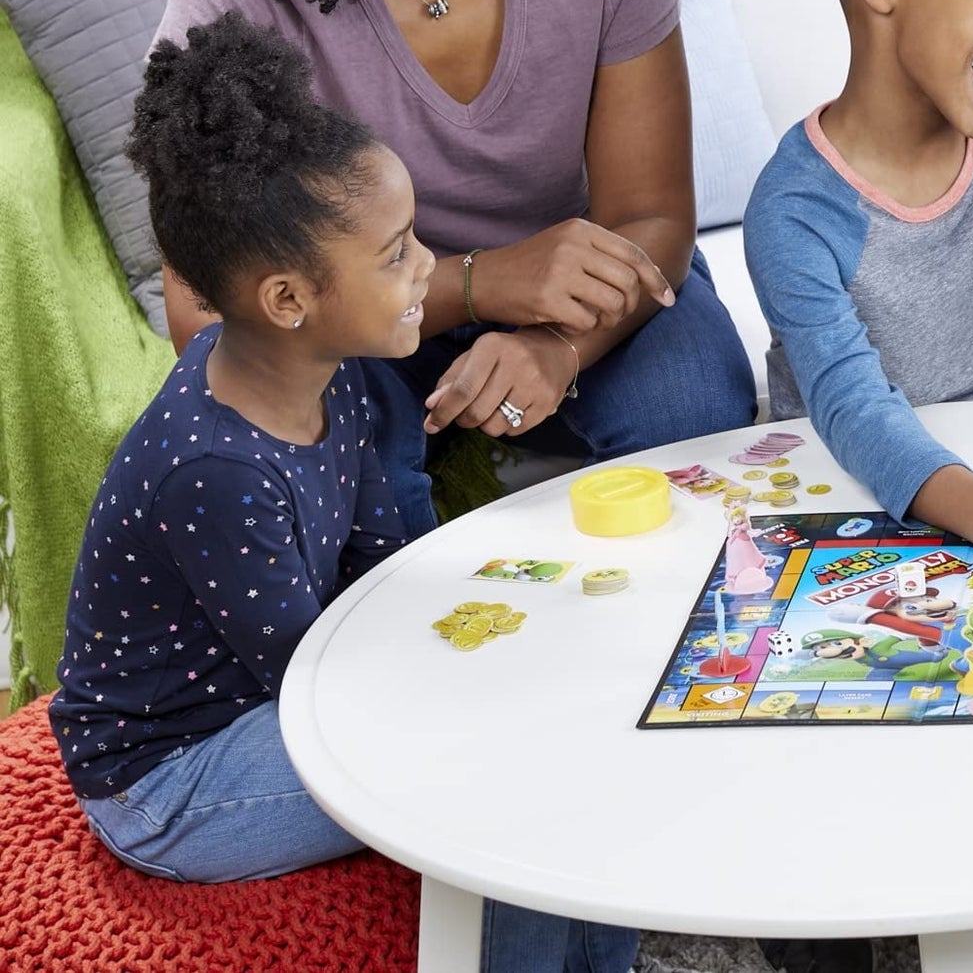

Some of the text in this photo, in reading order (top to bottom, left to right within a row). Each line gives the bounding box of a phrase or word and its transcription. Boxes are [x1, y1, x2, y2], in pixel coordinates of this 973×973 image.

[810, 549, 878, 575] SUPER
[815, 551, 902, 585] MARIO
[816, 552, 948, 604] MONOLY
